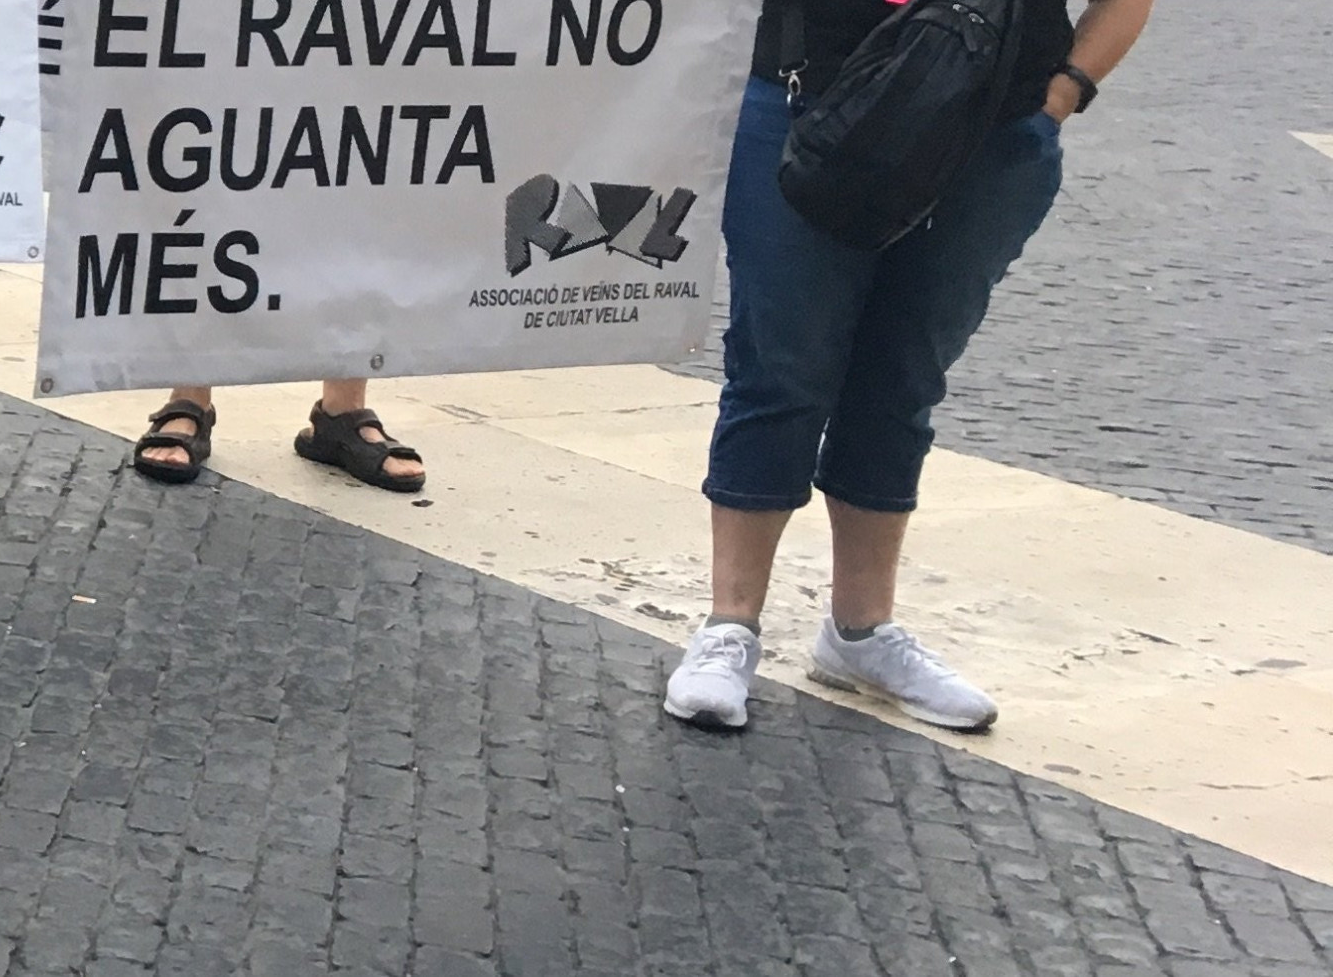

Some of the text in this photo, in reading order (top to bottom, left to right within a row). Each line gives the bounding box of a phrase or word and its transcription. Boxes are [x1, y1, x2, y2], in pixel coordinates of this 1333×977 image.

[78, 105, 496, 194] AGUANTA
[76, 210, 281, 319] MÉS.
[469, 284, 559, 307] ASSOCIACIÓ
[561, 287, 579, 304] DE
[623, 283, 650, 300] DEL
[654, 281, 700, 299] RAVAL
[524, 306, 639, 329] DE CIUTAT VELLA
